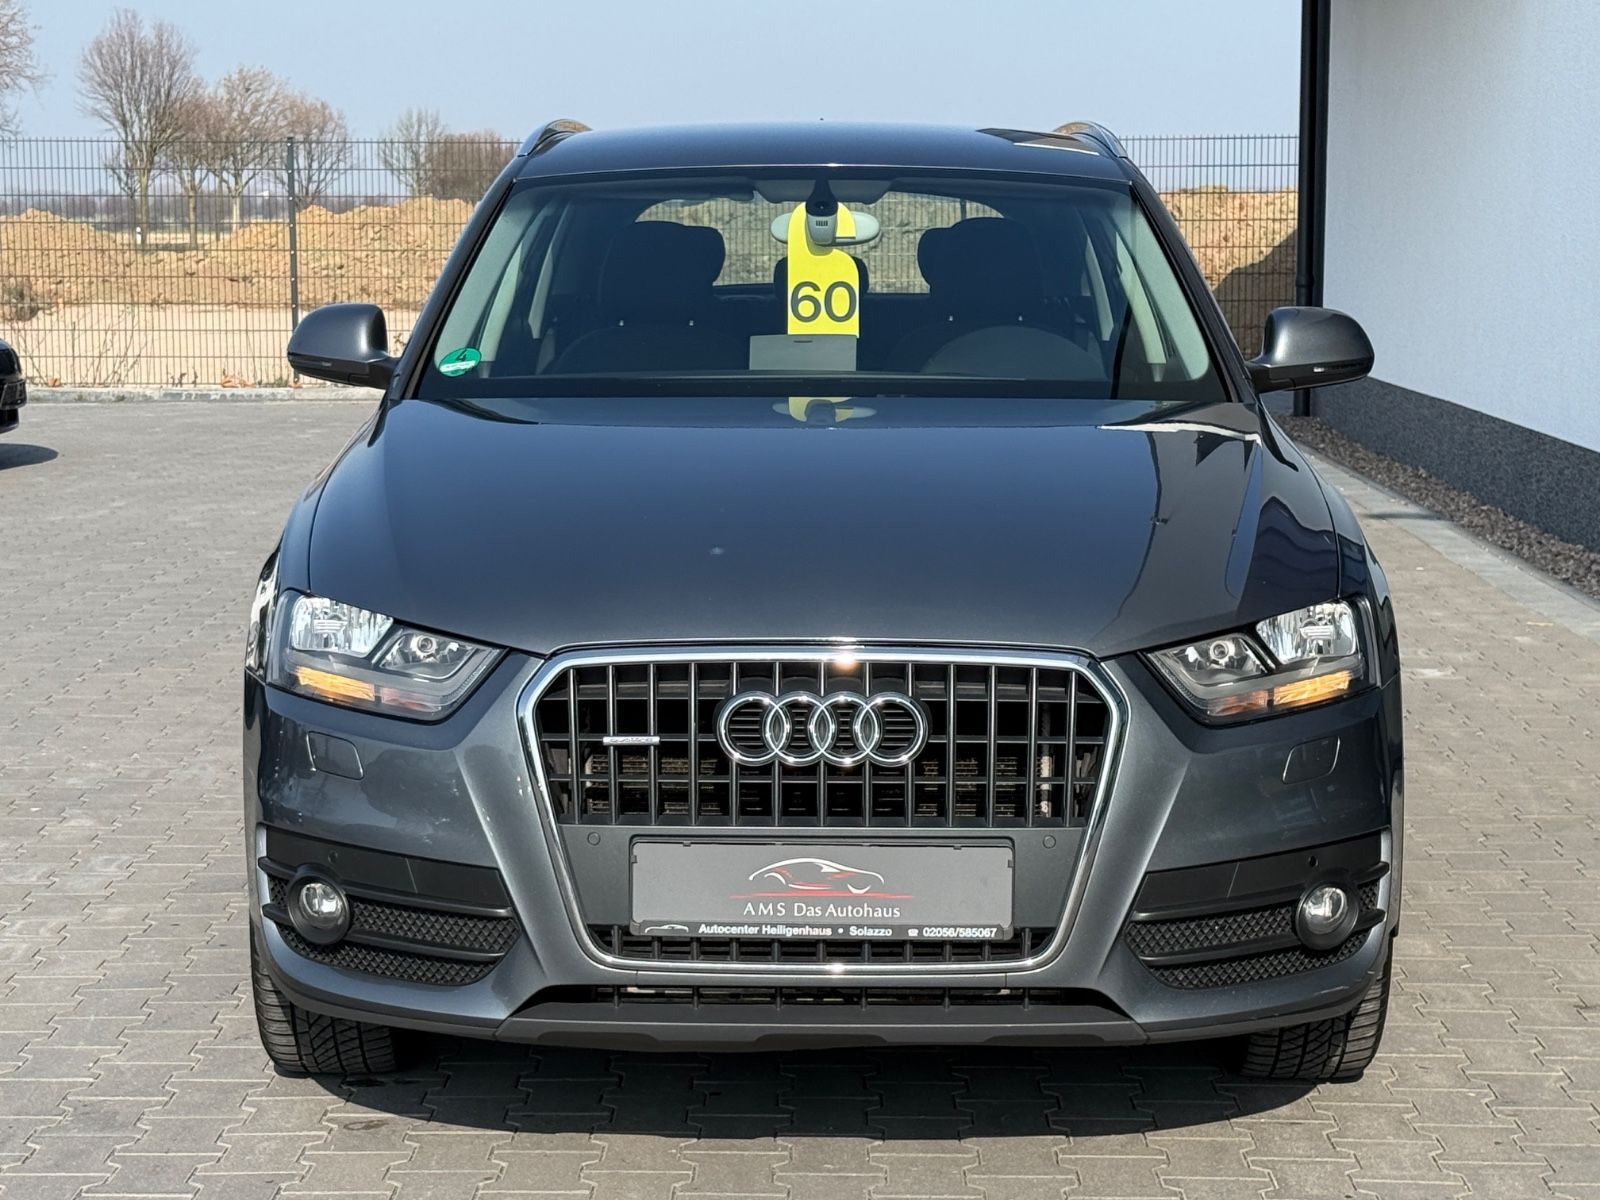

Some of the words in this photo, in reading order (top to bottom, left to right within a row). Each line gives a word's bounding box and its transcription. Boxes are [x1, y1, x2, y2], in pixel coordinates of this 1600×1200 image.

[790, 281, 857, 323] 60
[794, 902, 822, 917] Das
[825, 902, 901, 918] Autohaus
[698, 923, 759, 935] Autocenter
[762, 924, 832, 937] Heiligenhaus
[849, 925, 893, 937] Solazzo
[922, 926, 997, 938] 02056/585067
